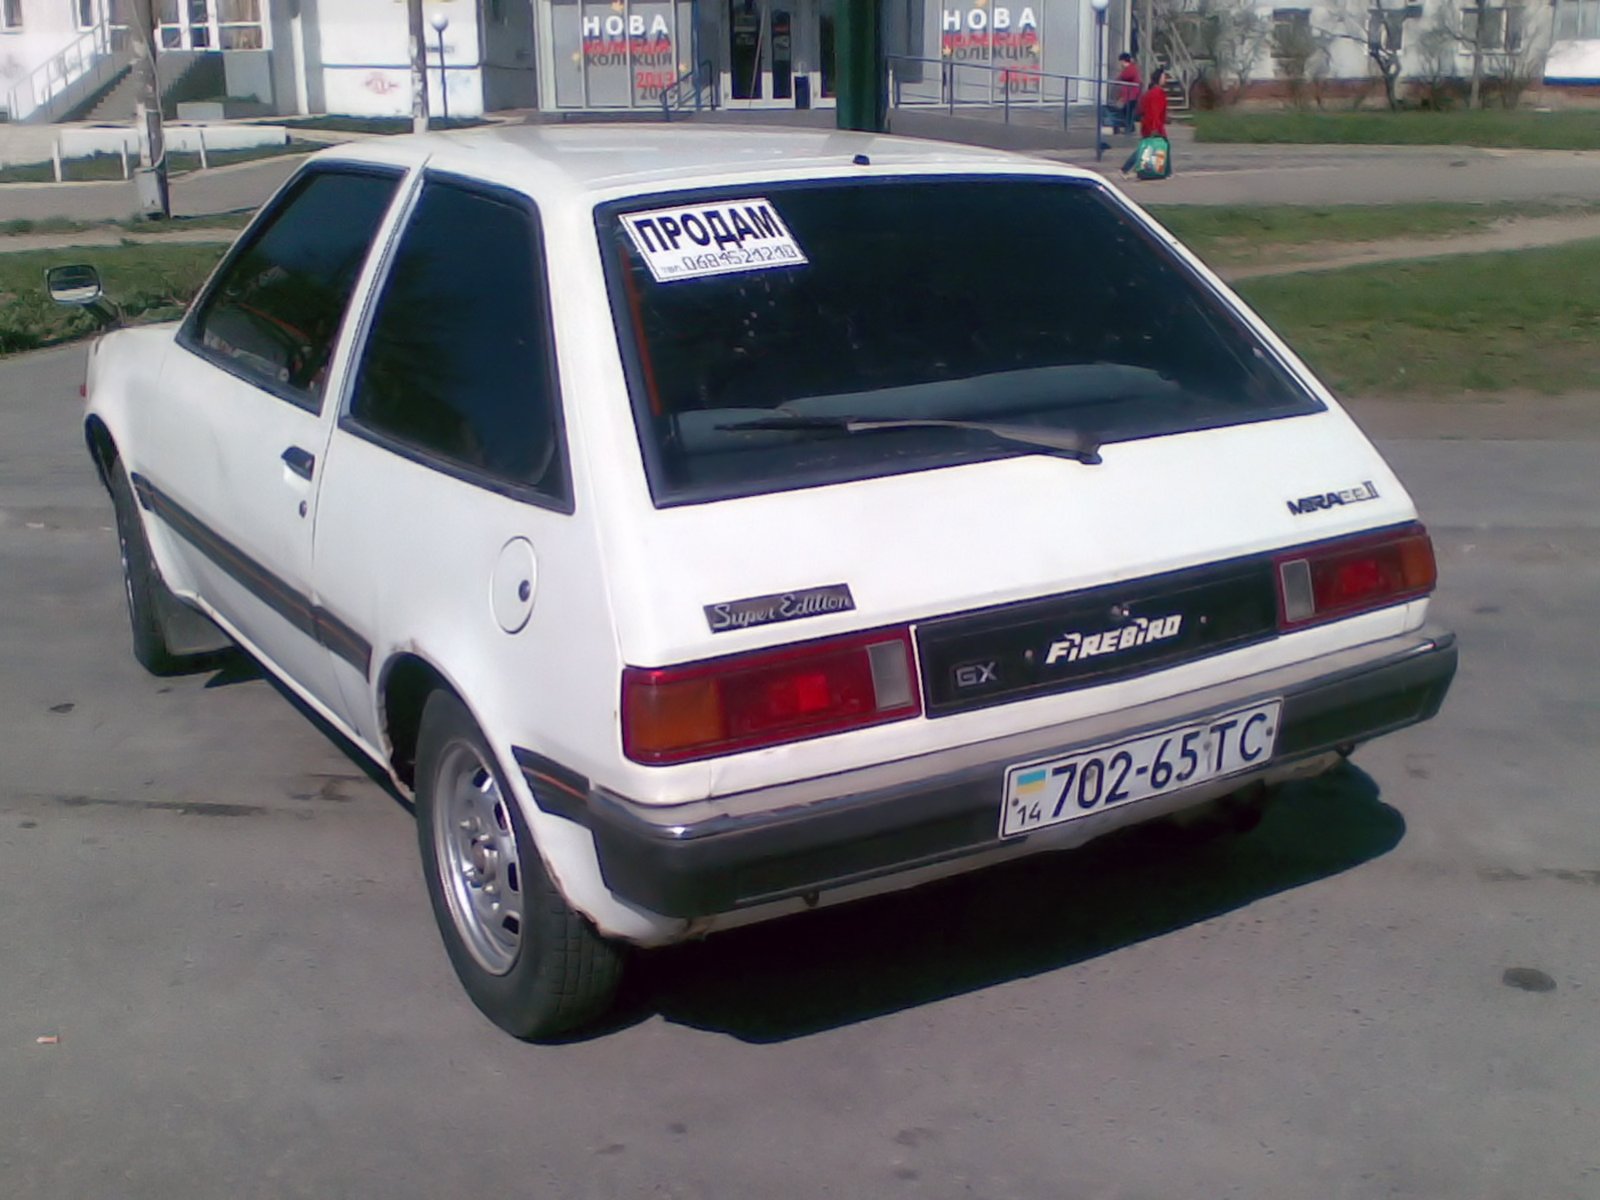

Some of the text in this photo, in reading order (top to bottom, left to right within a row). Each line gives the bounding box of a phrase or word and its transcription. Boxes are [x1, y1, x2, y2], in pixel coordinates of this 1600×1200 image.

[583, 14, 668, 37] НОВА
[942, 7, 1037, 30] НОВА
[632, 205, 785, 253] ПРОДАМ
[712, 593, 850, 628] Super Edition
[955, 662, 998, 688] GX
[1016, 803, 1042, 826] 14
